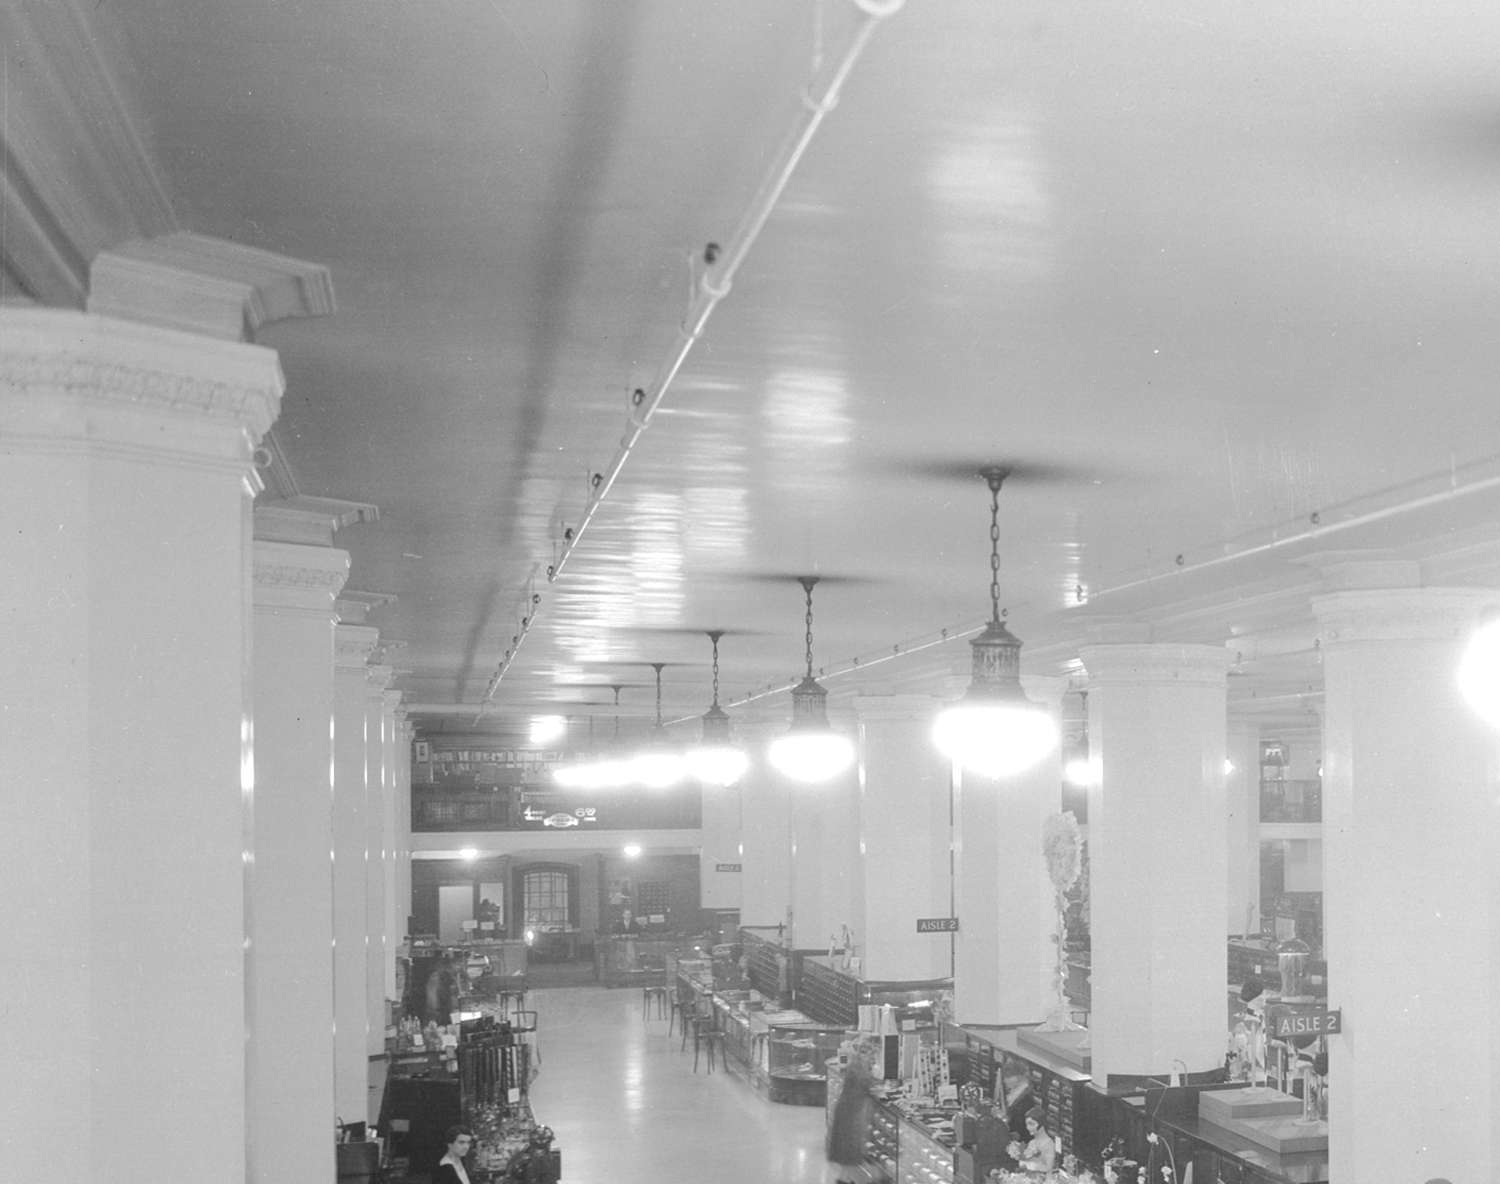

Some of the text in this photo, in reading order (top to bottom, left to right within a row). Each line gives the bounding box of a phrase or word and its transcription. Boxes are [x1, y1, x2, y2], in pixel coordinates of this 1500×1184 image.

[920, 920, 956, 931] AISLE 2
[1280, 1015, 1337, 1033] AISLE 2
